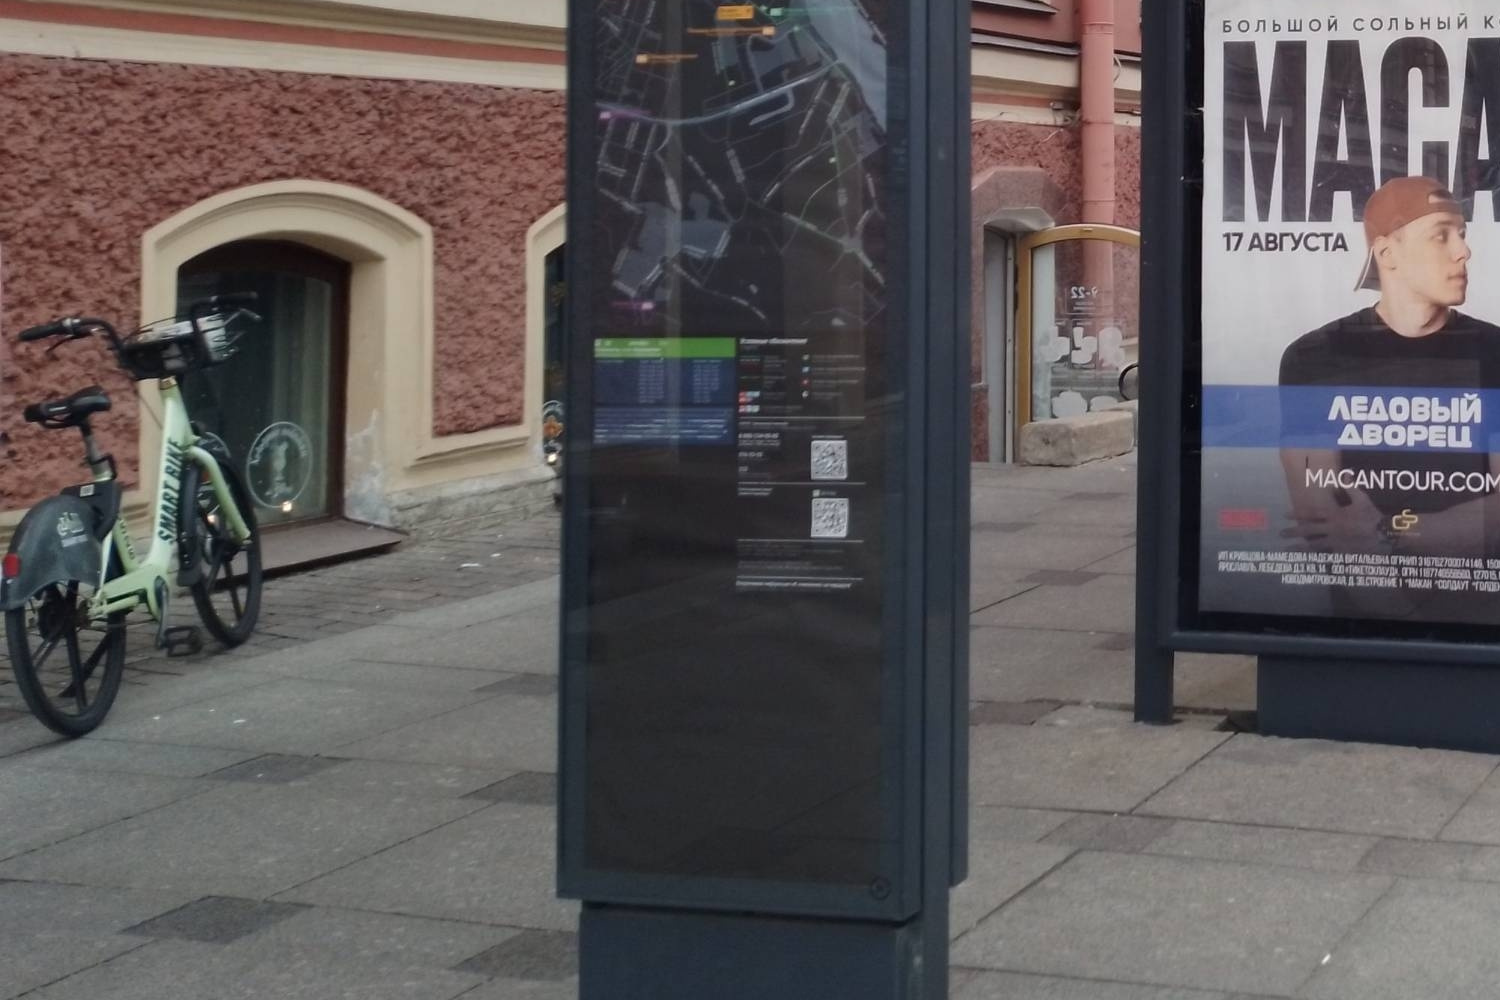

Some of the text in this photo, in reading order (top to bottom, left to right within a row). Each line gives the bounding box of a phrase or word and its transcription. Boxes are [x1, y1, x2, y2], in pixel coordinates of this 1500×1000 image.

[1223, 15, 1338, 33] БОЛЬШОЙ
[1353, 12, 1468, 31] СОЛЬНЫЙ
[1223, 231, 1349, 253] 17 АВГУСТА
[1328, 393, 1482, 423] ЛЕДОВЫЙ
[1337, 423, 1473, 448] ДВОРЕЦ
[157, 480, 178, 544] SMART
